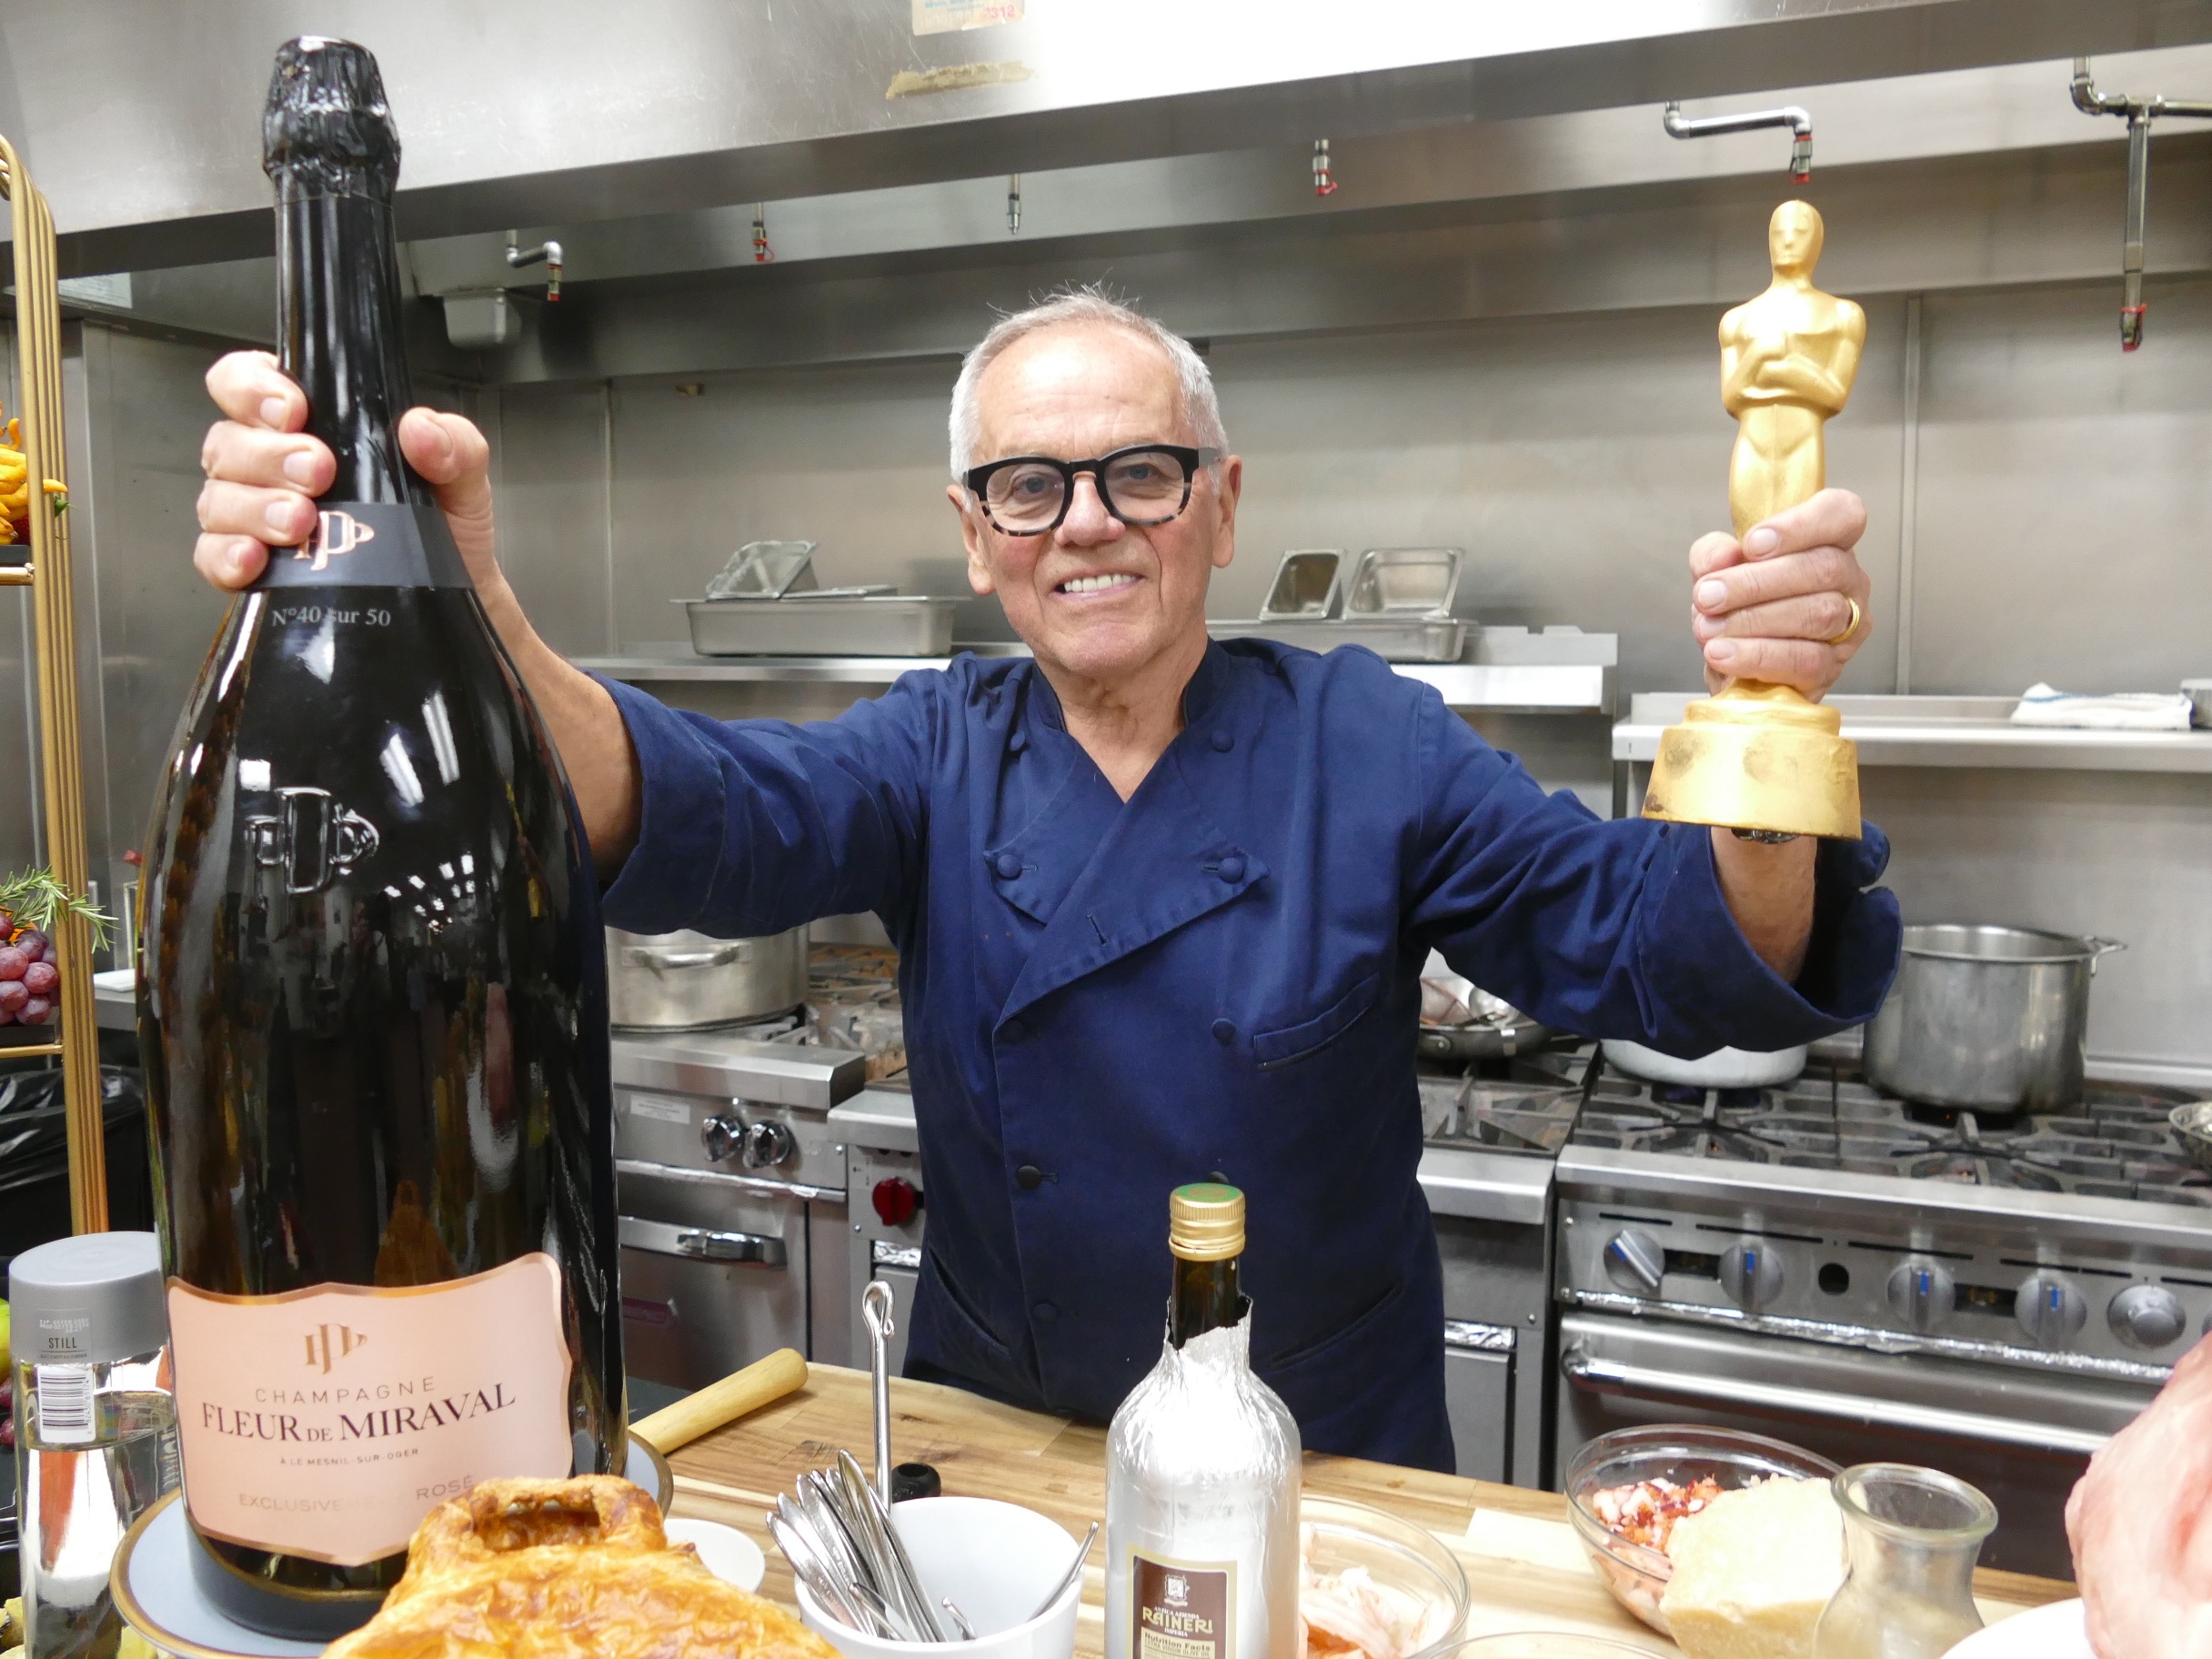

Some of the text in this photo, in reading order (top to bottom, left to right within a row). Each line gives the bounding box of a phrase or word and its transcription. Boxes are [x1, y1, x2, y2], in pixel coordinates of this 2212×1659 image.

[365, 607, 392, 627] 50
[48, 1337, 77, 1349] STILL
[255, 1375, 436, 1404] CHAMPAGNE
[202, 1382, 517, 1443] FLEUR DE MIRAVAL
[417, 1473, 474, 1501] ROSÉ
[1142, 1606, 1213, 1634] RAINERI
[1144, 1632, 1211, 1652] Nutrition Facts
